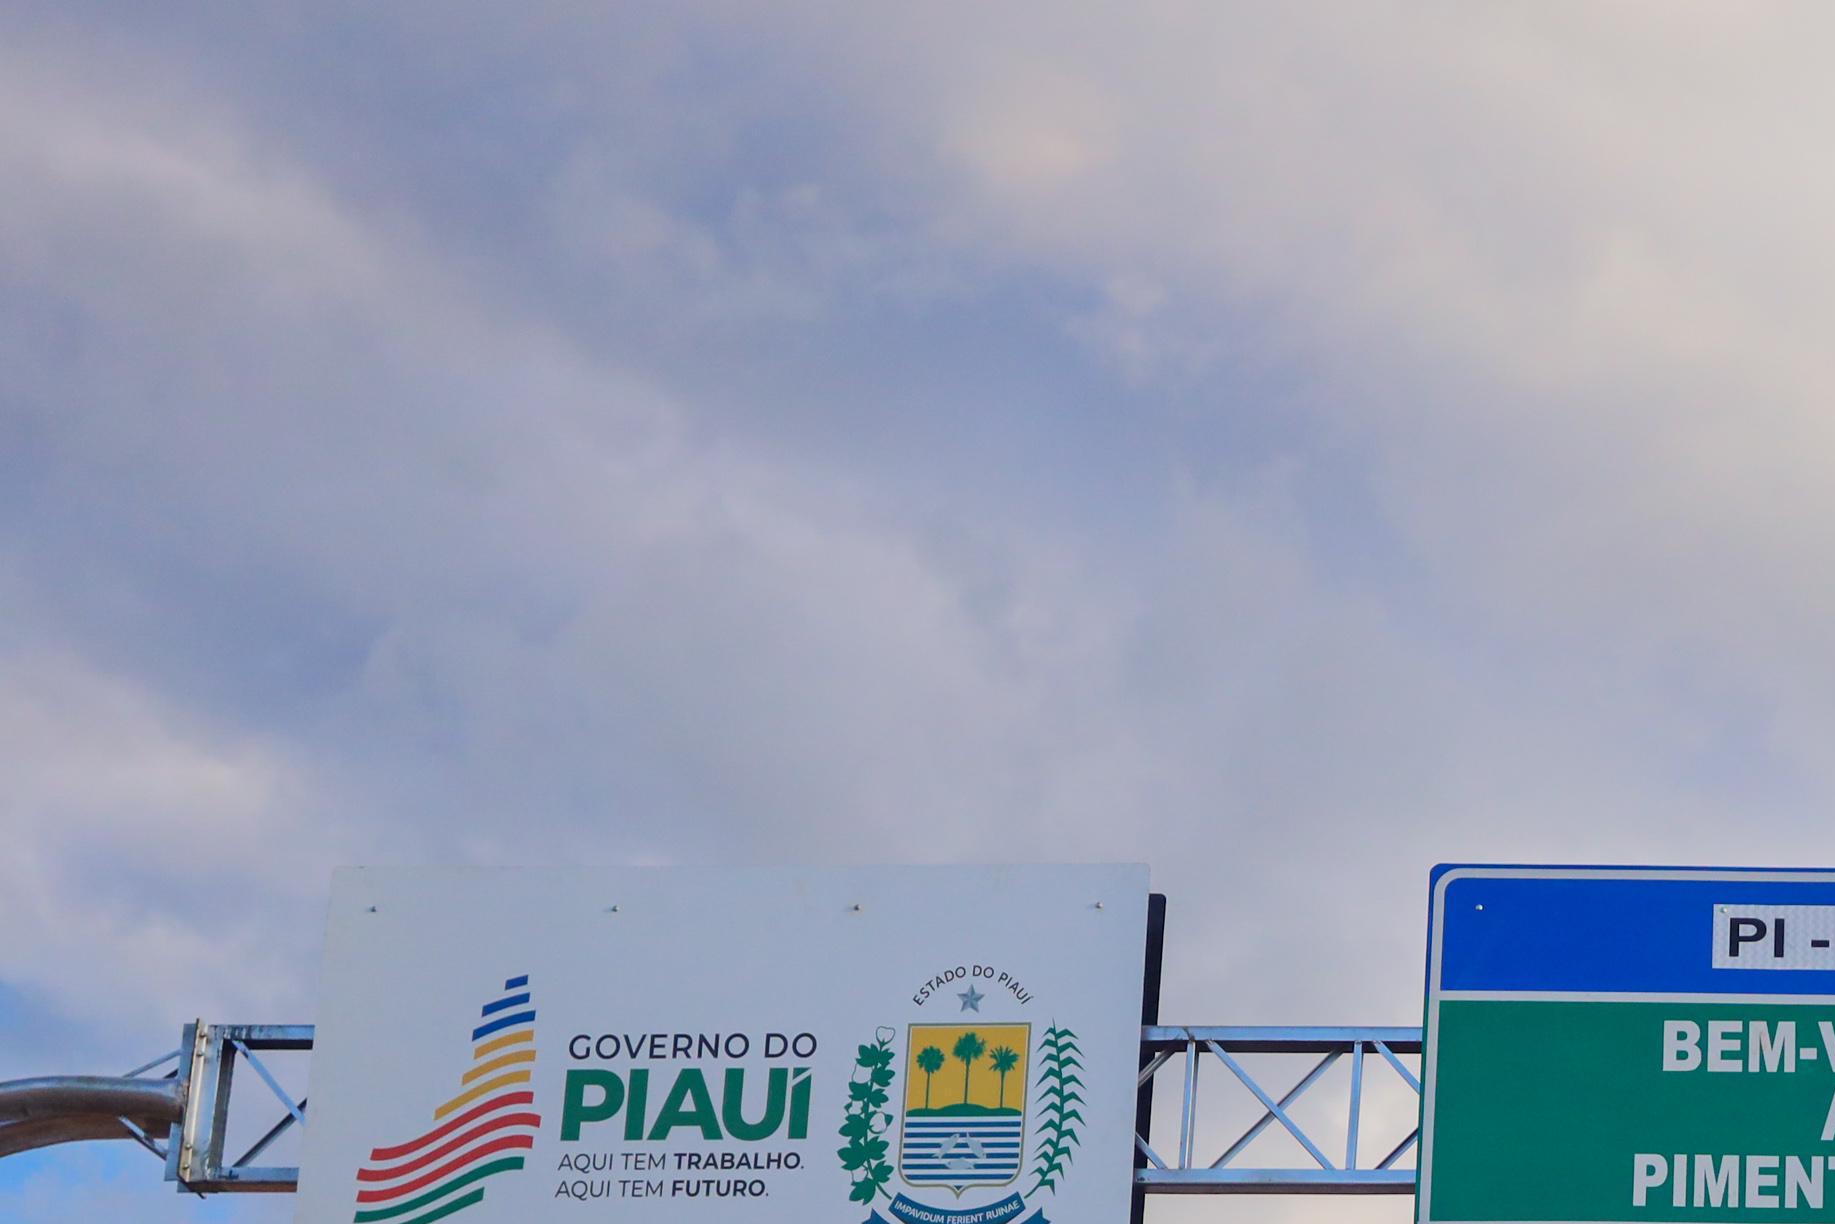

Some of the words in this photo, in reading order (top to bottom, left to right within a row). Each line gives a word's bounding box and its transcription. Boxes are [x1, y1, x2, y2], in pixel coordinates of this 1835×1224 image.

[1727, 918, 1786, 959] PI
[912, 966, 966, 1006] ESTADO
[972, 965, 995, 979] DO
[997, 972, 1034, 1005] PIAUÍ
[568, 1033, 750, 1060] GOVERNO
[764, 1032, 818, 1059] DO
[560, 1067, 812, 1142] PIAUÍ
[557, 1153, 613, 1174] AQUI
[621, 1153, 666, 1170] TEM
[673, 1152, 805, 1171] TRABALHO.
[554, 1180, 611, 1201] AQUI
[618, 1180, 664, 1197] TEM
[671, 1179, 769, 1198] FUTURO.
[894, 1200, 944, 1223] IMPAVIDUM
[946, 1213, 984, 1224] FERIENT
[985, 1199, 1020, 1220] RUINAE
